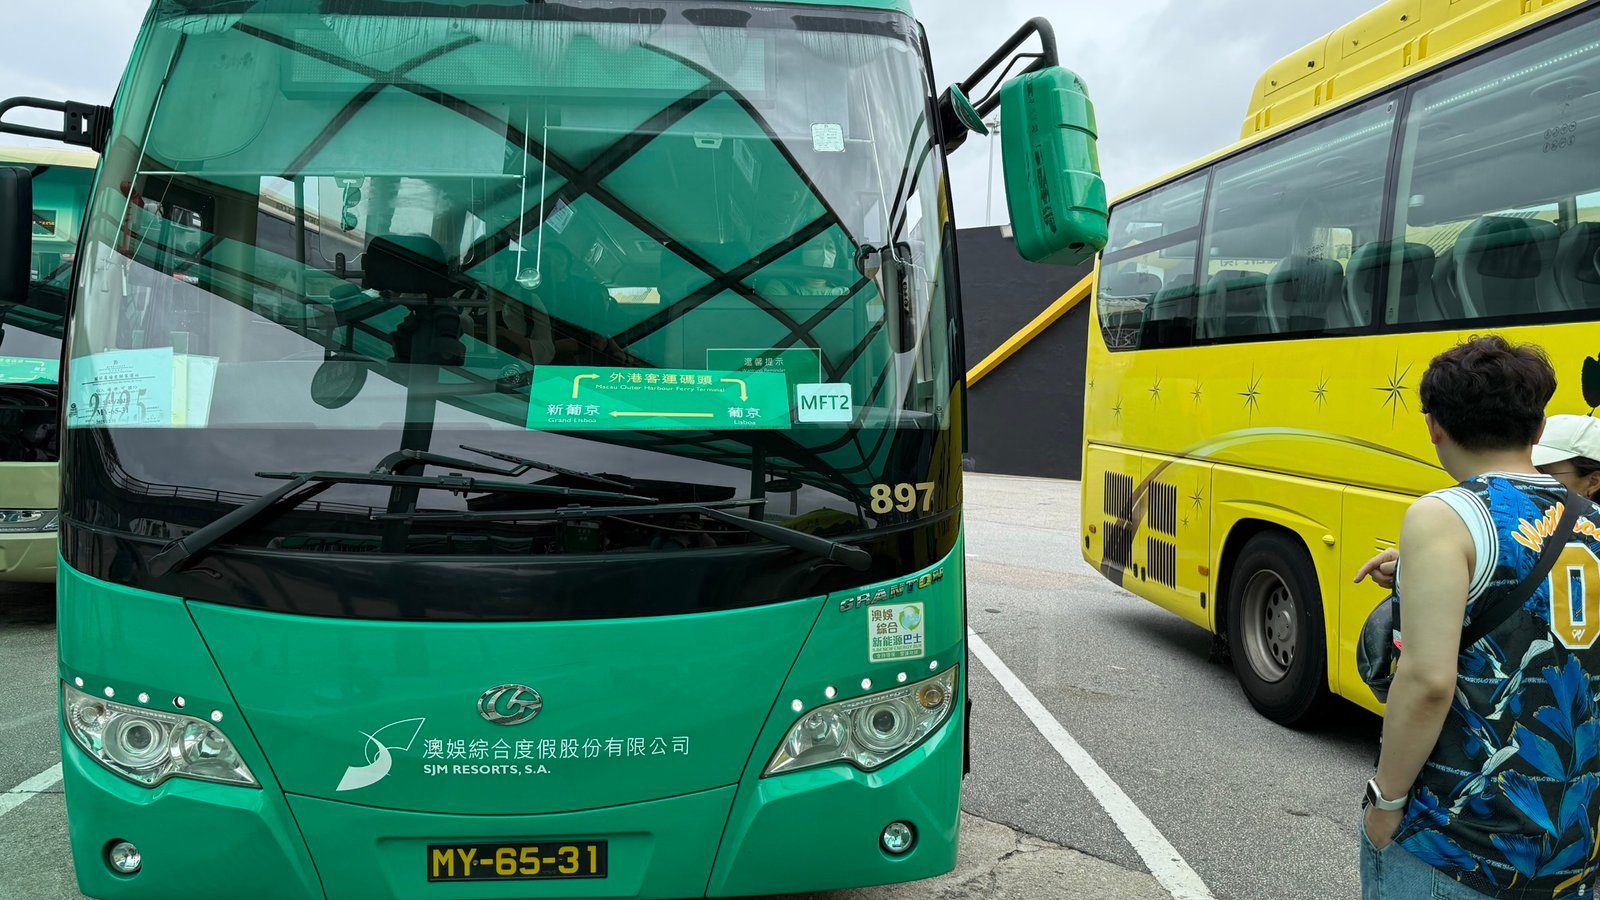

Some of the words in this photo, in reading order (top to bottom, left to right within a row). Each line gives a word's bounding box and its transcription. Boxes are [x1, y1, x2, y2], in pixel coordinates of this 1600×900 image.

[608, 372, 713, 385] 外港客運碼頭
[801, 394, 849, 410] MFT2
[546, 403, 601, 416] 新葡京
[728, 406, 761, 419] 葡京
[870, 482, 935, 514] 897
[839, 567, 944, 612] GRANTON
[1547, 542, 1600, 650] 0
[872, 609, 893, 621] 澳娛
[877, 622, 898, 634] 綜合
[873, 633, 922, 647] 新能源巴士
[422, 735, 690, 760] 澳娛綜合度假股份有限公司
[423, 764, 448, 776] SJM
[452, 764, 522, 775] RESORTS,
[524, 764, 551, 774] S.A.
[431, 844, 597, 877] MY-65-31
